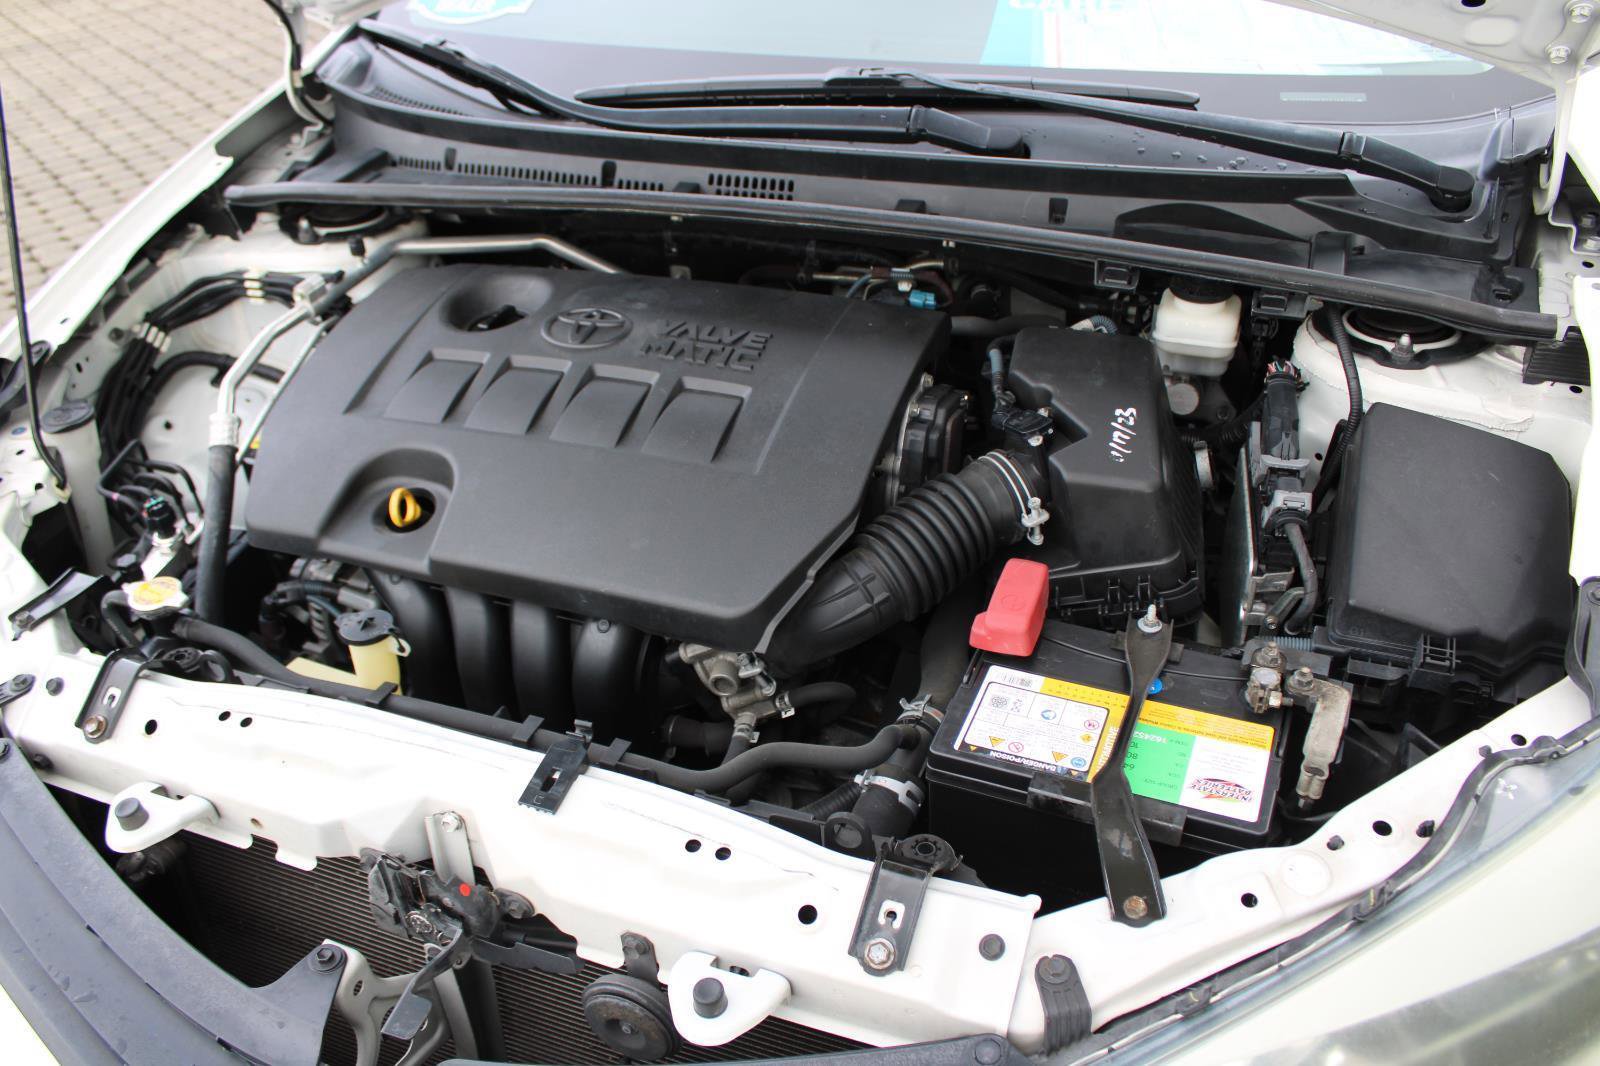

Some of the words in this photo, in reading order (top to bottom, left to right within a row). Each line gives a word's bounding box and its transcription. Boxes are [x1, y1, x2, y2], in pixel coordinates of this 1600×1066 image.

[656, 320, 774, 351] VALVE
[640, 340, 763, 371] MATIC
[990, 750, 1057, 772] DANGER/POISON
[1191, 783, 1252, 802] INTERSTATE
[1196, 778, 1252, 796] BATTERIES
